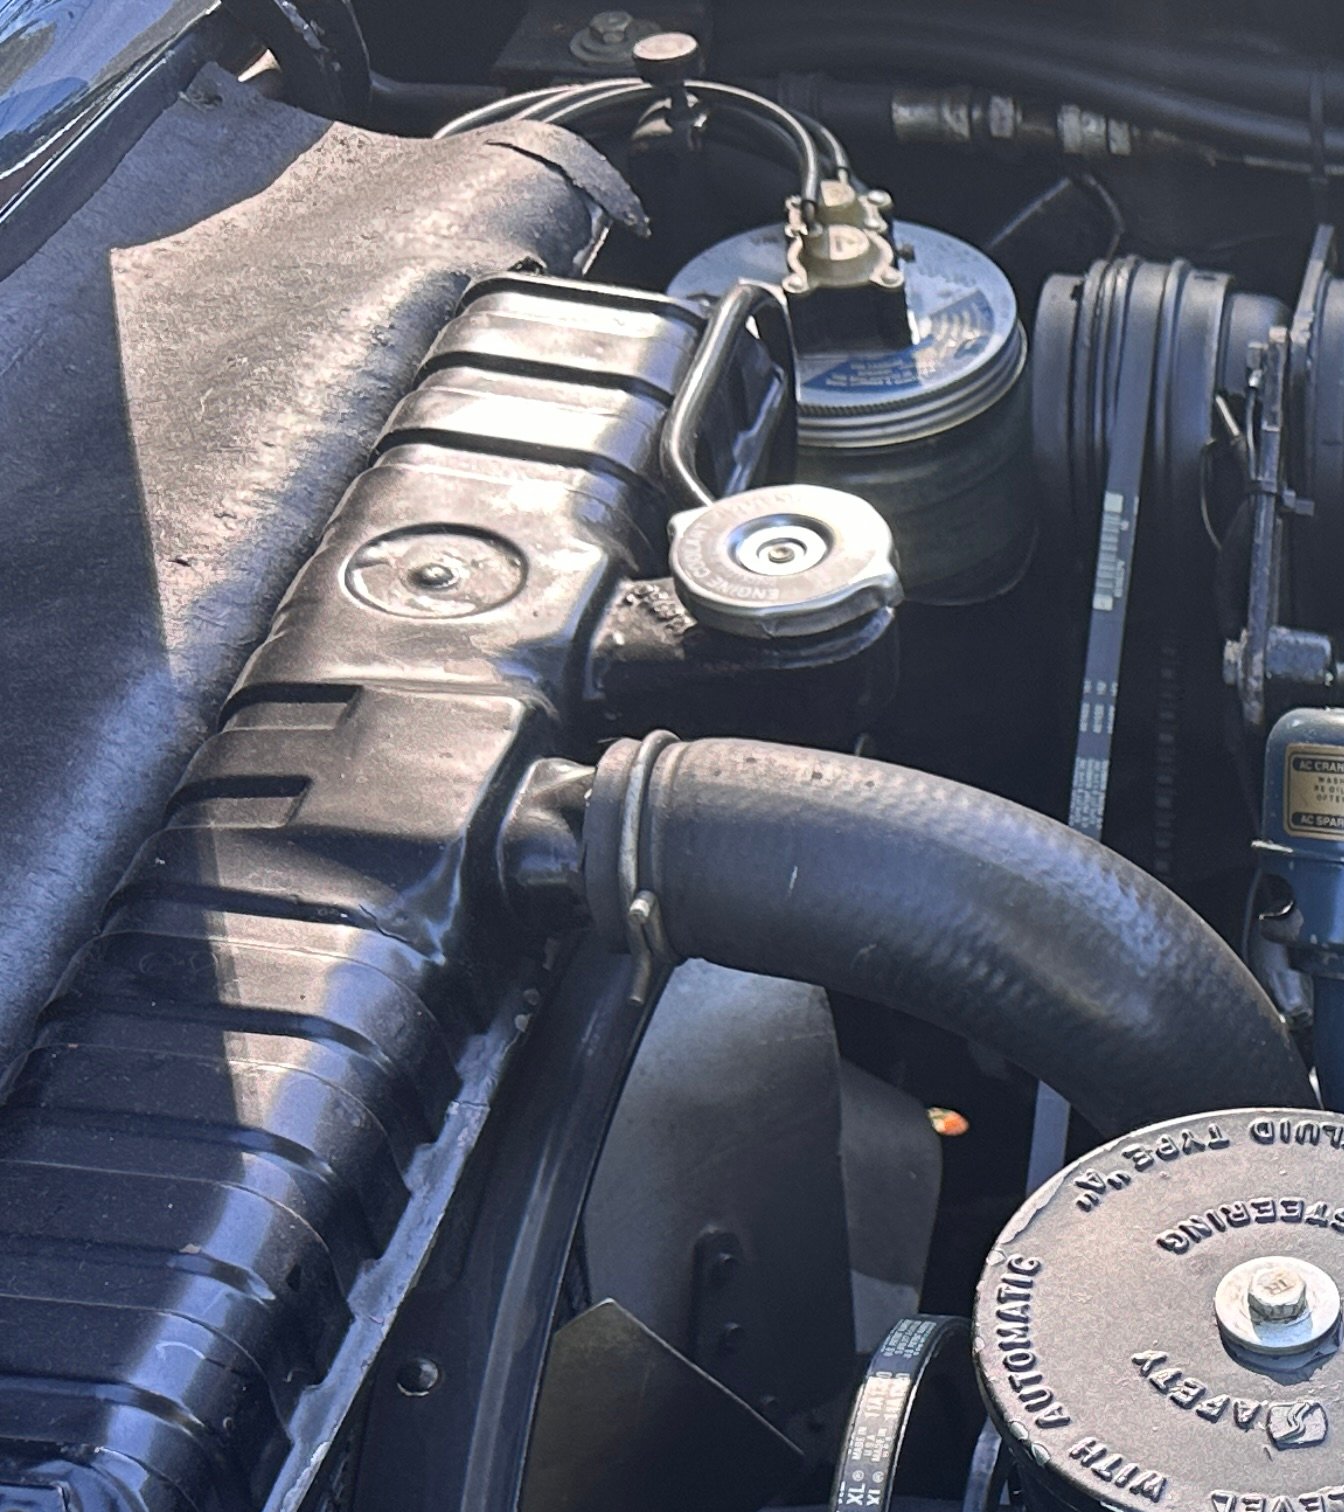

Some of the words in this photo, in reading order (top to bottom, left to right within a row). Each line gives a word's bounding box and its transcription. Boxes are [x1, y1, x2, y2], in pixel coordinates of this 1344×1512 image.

[1123, 1122, 1231, 1173] TYPE
[994, 1253, 1073, 1430] AUTOMATIC
[846, 1482, 867, 1506] XL
[1067, 1436, 1170, 1503] WITH
